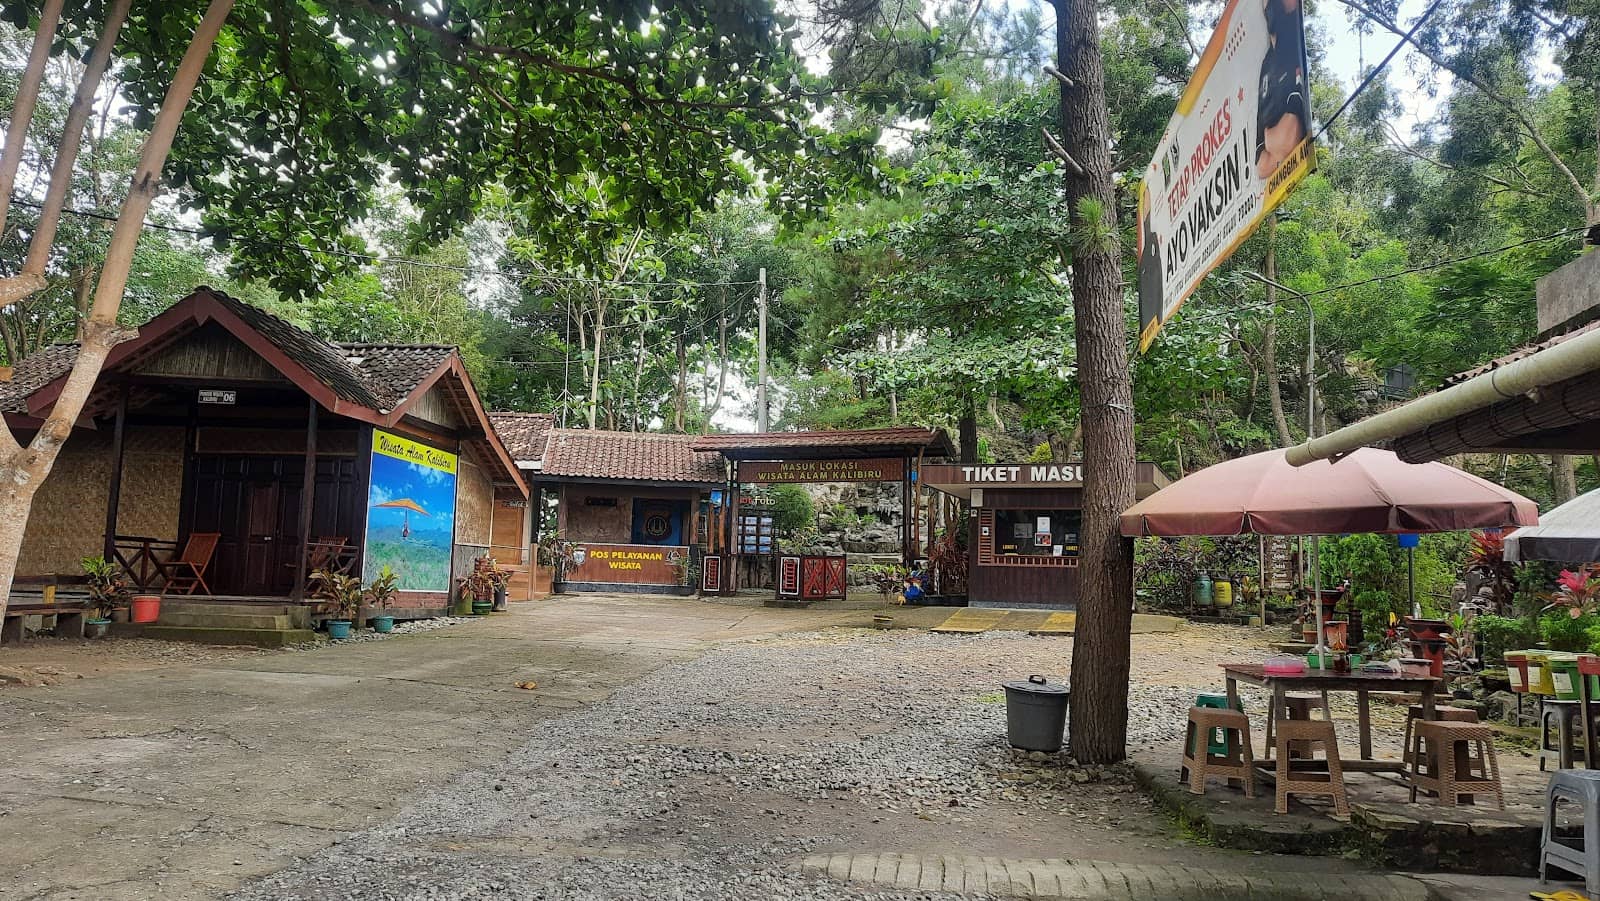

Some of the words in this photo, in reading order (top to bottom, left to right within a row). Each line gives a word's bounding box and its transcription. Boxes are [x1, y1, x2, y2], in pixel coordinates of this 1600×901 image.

[1168, 165, 1190, 221] TETAP
[1191, 98, 1231, 185] PROKES
[1166, 220, 1188, 282] AYO
[1188, 143, 1240, 247] VAKSIN
[223, 393, 234, 402] 06
[380, 435, 404, 455] Wisata
[406, 445, 424, 461] Alam
[426, 450, 451, 468] Kalibiru
[780, 463, 816, 471] MASUK
[820, 462, 858, 470] LOKASI
[758, 472, 795, 480] WISATA
[800, 471, 828, 480] ALAM
[832, 470, 881, 479] KALIBIRU
[962, 467, 1020, 482] TIKET
[1030, 466, 1083, 482] MASU
[590, 551, 609, 559] POS
[611, 551, 662, 560] PELAYANAN
[608, 561, 642, 570] WISATA
